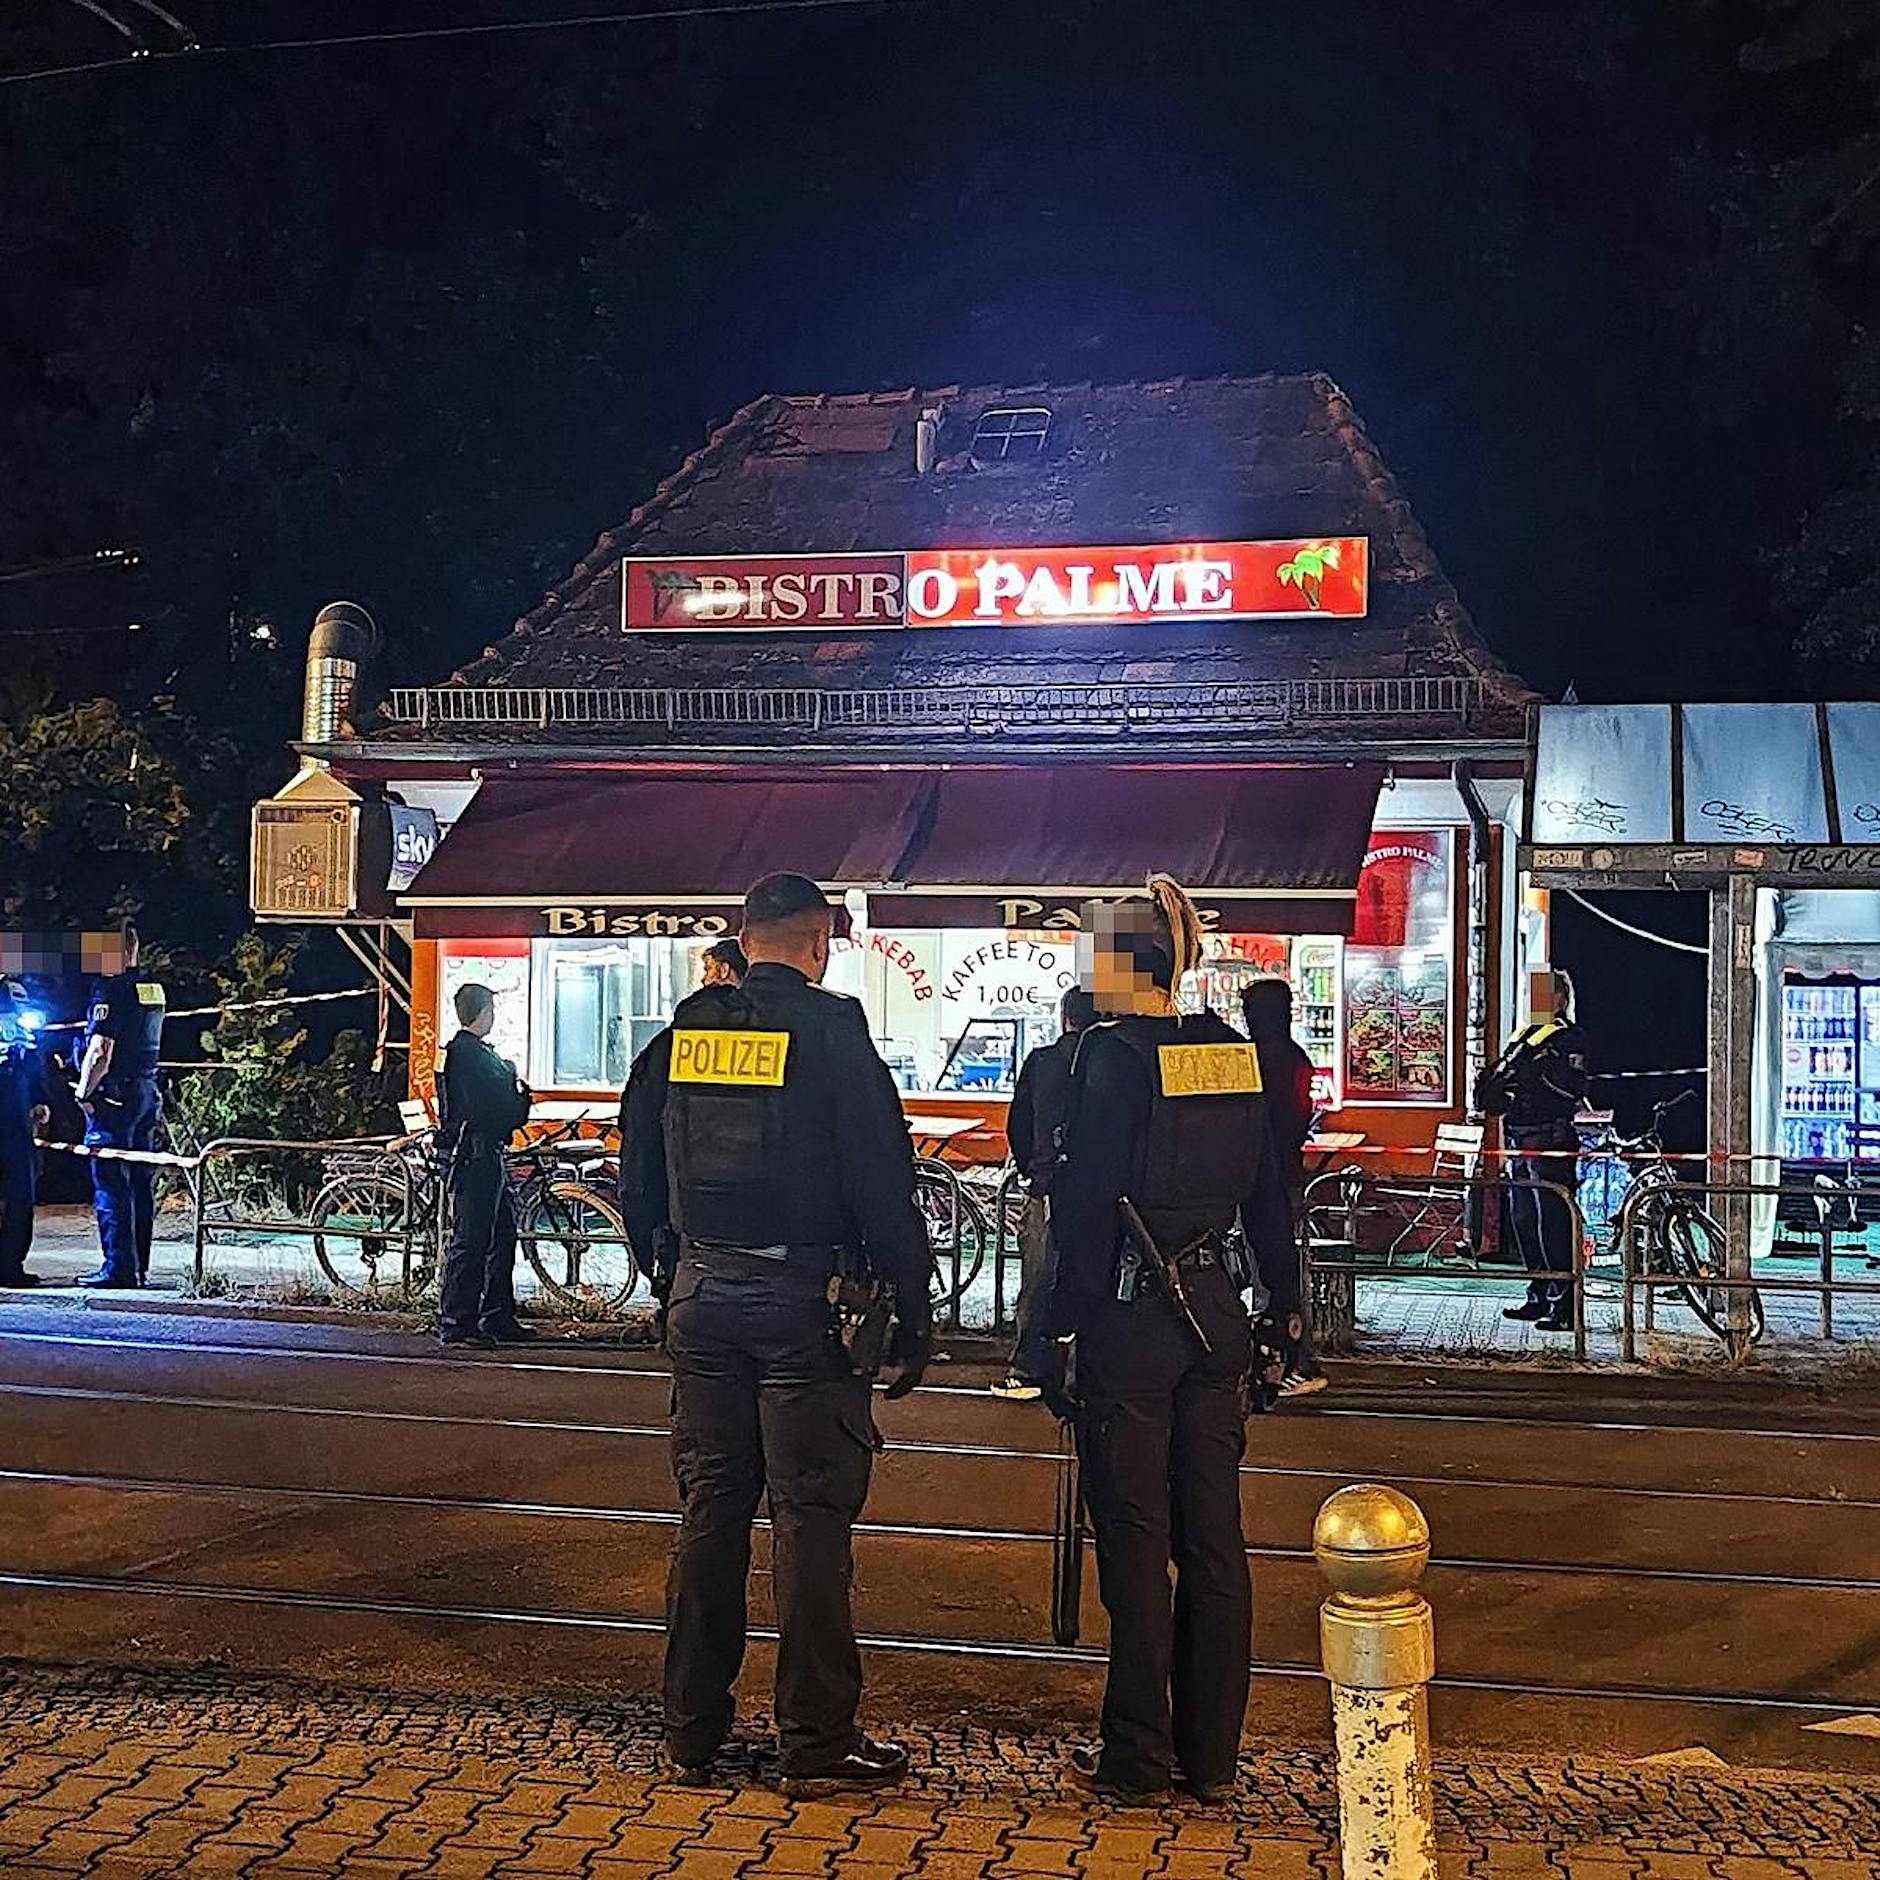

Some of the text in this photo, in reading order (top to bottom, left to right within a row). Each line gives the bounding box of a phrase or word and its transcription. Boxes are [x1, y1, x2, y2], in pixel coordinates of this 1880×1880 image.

[695, 560, 1233, 620] BISTRO PALME
[397, 824, 435, 865] sky
[542, 908, 728, 935] Bistro
[996, 899, 1219, 932] Pae
[871, 934, 933, 1001] KEBAB
[942, 941, 1077, 1002] KAFFEE TO G
[978, 985, 1039, 1005] 1,00€
[675, 1038, 784, 1078] POLIZEI
